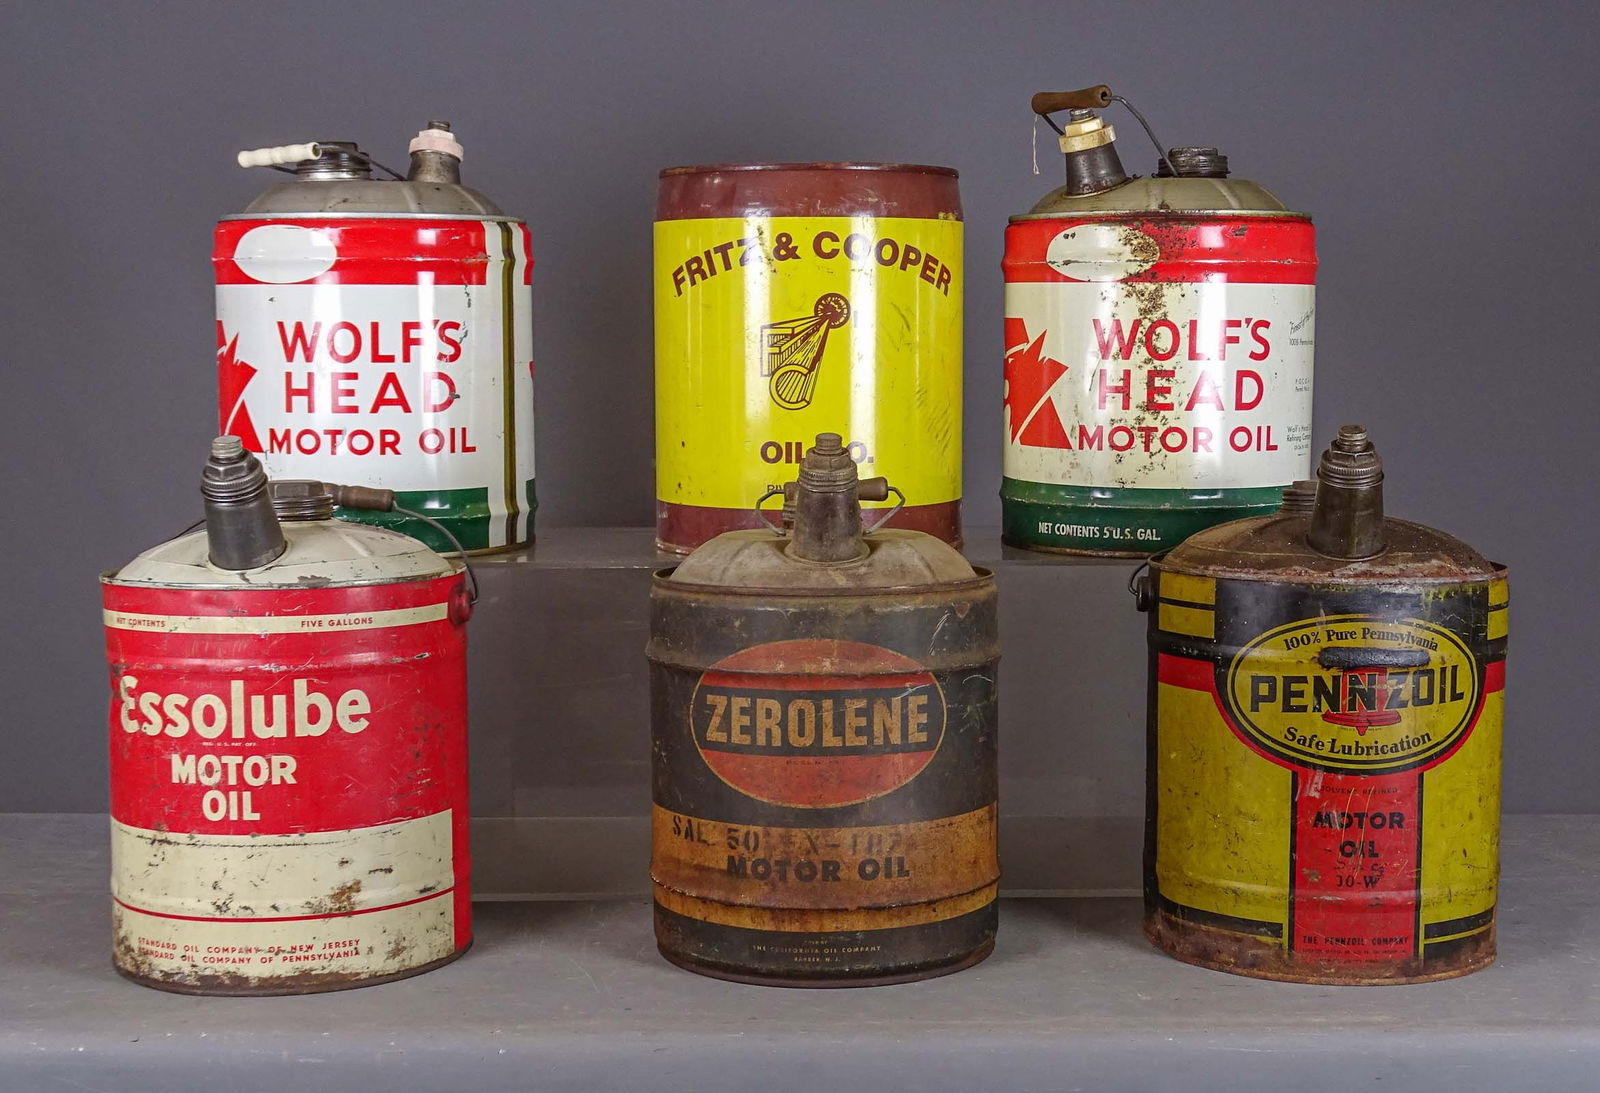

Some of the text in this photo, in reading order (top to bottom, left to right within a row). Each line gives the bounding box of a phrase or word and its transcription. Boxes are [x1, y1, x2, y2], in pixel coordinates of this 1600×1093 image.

[671, 231, 952, 297] FRITZ & COOPER
[276, 319, 463, 363] WOLF'S
[1092, 317, 1272, 362] WOLF'S
[284, 371, 458, 414] HEAD
[1098, 369, 1265, 412] HEAD
[268, 427, 477, 456] MOTOR OIL
[847, 441, 875, 464] O.
[1078, 424, 1279, 453] MOTOR OIL
[1038, 521, 1053, 534] NET
[1054, 523, 1100, 538] CONTENTS
[1102, 526, 1110, 539] 5
[1136, 528, 1162, 541] GAL.
[128, 618, 166, 628] CONTENTS
[301, 620, 323, 628] FIVE
[327, 617, 374, 627] GALLONS
[1283, 627, 1439, 652] 100% Pure Pennsylvania
[1250, 664, 1465, 713] PENNZOIL
[119, 674, 371, 739] Essolube
[705, 694, 928, 748] ZEROLENE
[1284, 726, 1433, 757] Safe Lubrication
[171, 754, 298, 785] MOTOR
[201, 790, 261, 822] OIL
[1312, 811, 1405, 829] MOTOR
[727, 827, 760, 852] 50
[1340, 840, 1379, 858] OIL
[726, 855, 910, 882] MOTOR OIL
[138, 937, 177, 950] STANDARD
[183, 944, 200, 953] OIL
[206, 946, 260, 954] COMPANY
[290, 944, 314, 952] NEW
[322, 939, 361, 950] JERSEY
[1302, 935, 1409, 946] THE PENNZOIL COMPANY
[138, 947, 361, 964] STANDARD OIL COMPANY OF PENNSYLVANIA
